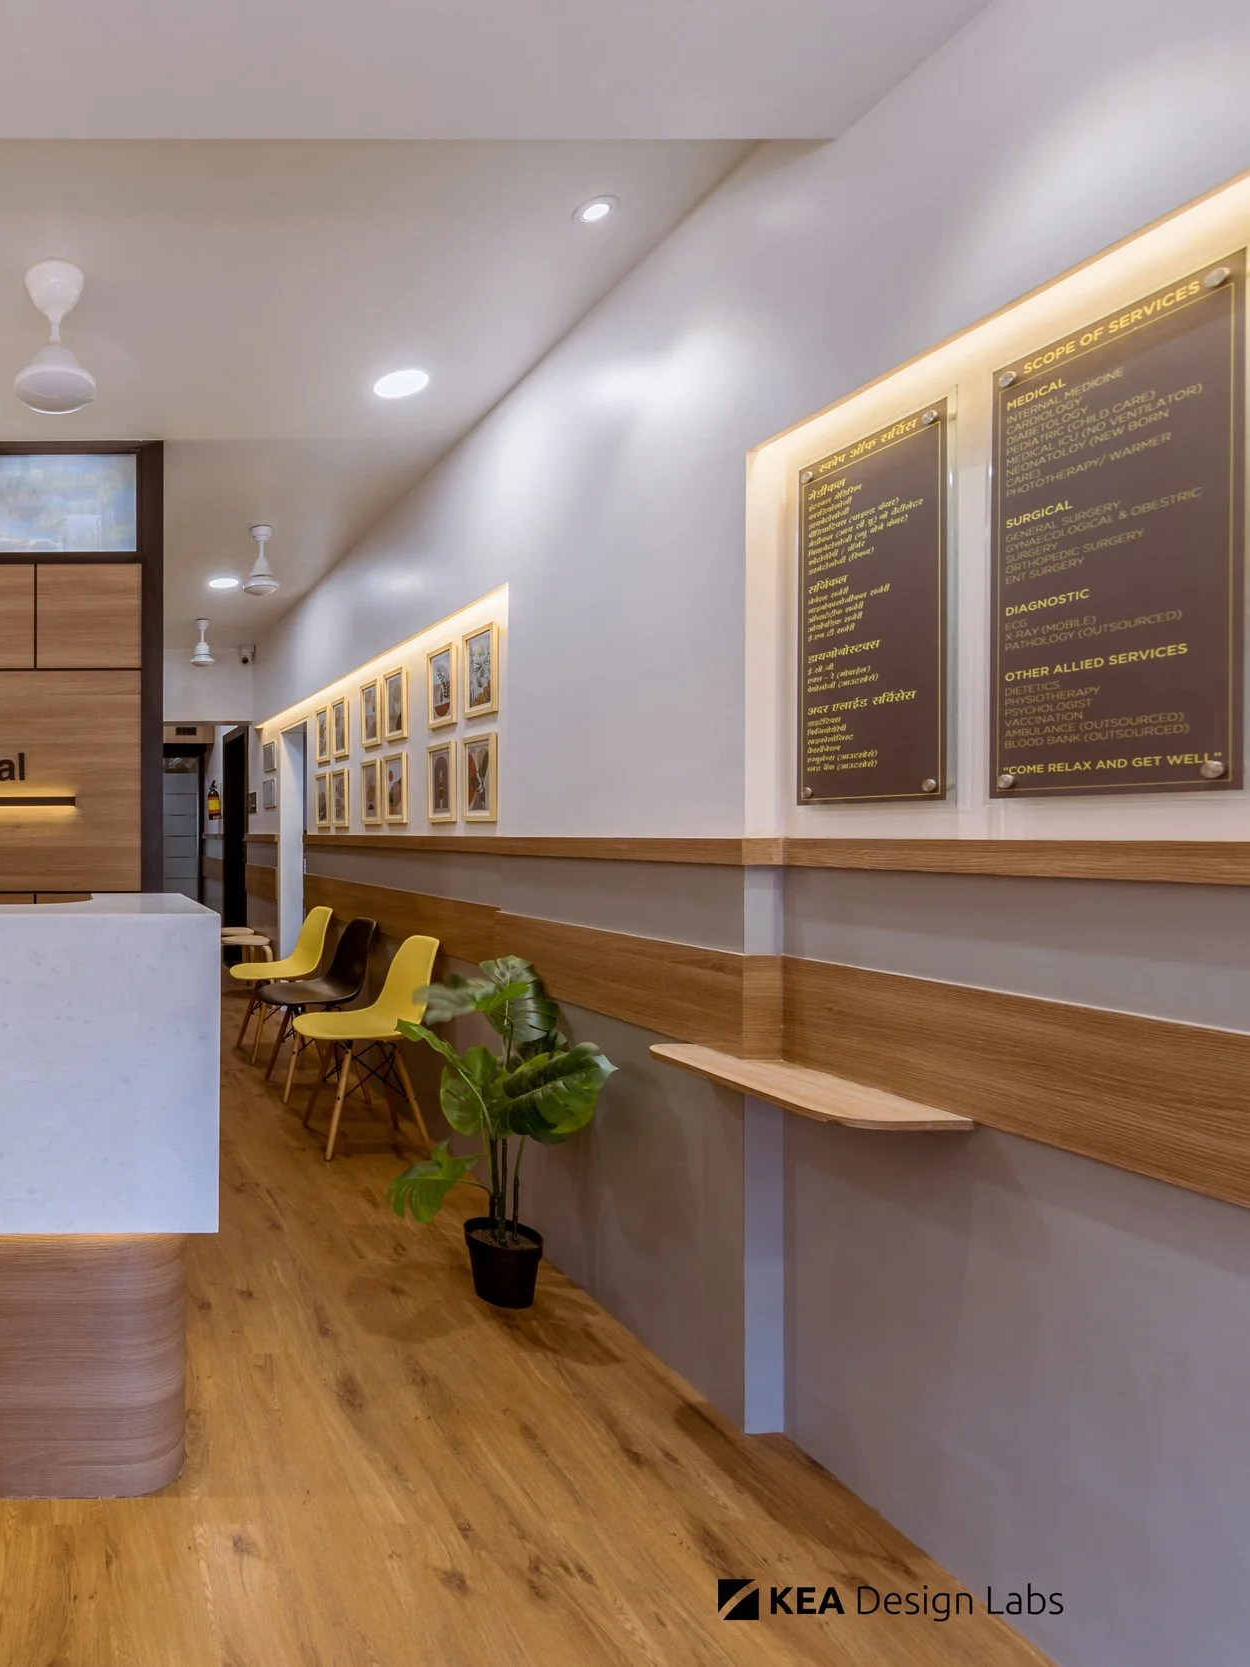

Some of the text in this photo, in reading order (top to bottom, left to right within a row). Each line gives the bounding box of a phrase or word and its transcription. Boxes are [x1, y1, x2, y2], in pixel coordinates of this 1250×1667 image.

[1023, 280, 1201, 374] SCOPE OF SERVICES
[1006, 378, 1066, 411] MEDICAL
[1006, 366, 1124, 425] INTERNAL MEDICINE
[1006, 396, 1082, 434] CARDIOLOGY
[1006, 390, 1155, 456] PEDIATRIC (CHILD CARE)
[1006, 383, 1203, 467] MEDICAL ICU (NO VENTILATOR)
[1006, 405, 1088, 446] DIABETOLOGY
[1006, 409, 1169, 477] NEONATOLOY (NEW BORN
[1109, 432, 1172, 461] WARMER
[818, 454, 846, 472] स्कोप
[1006, 469, 1041, 487] CARE)
[1005, 500, 1073, 529] SURGICAL
[1005, 487, 1202, 553] GYNAECOLOGICAL & OBESTRIC
[1005, 500, 1121, 543] GENERAL SURGERY
[1005, 528, 1145, 574] ORTHOPEDIC SURGERY
[1005, 542, 1059, 564] SURGERY
[1005, 557, 1085, 585] ENT SURGERY
[1005, 588, 1090, 616] DIAGNOSTIC
[1005, 619, 1028, 631] ECG
[1005, 615, 1097, 641] X-RAY (MOBILE)
[1005, 609, 1183, 651] PATHOLOGY (OUTSOURCED)
[1005, 643, 1188, 682] OTHER ALLIED SERVICES
[1005, 680, 1061, 696] DIETETICS
[1005, 686, 1101, 707] PHYSIOTHERAPY
[807, 689, 917, 716] अदर एलाईड सर्विसेस
[1005, 698, 1094, 717] PSYCHOLOGIST
[1005, 711, 1083, 727] VACCINATION
[1005, 712, 1185, 738] AMBULANCE (OUTSOURCED)
[1004, 723, 1190, 749] BLOOD BANK (OUTSOURCED)
[1048, 761, 1092, 773] RELAX
[1095, 758, 1128, 770] AND
[1132, 756, 1162, 767] GET
